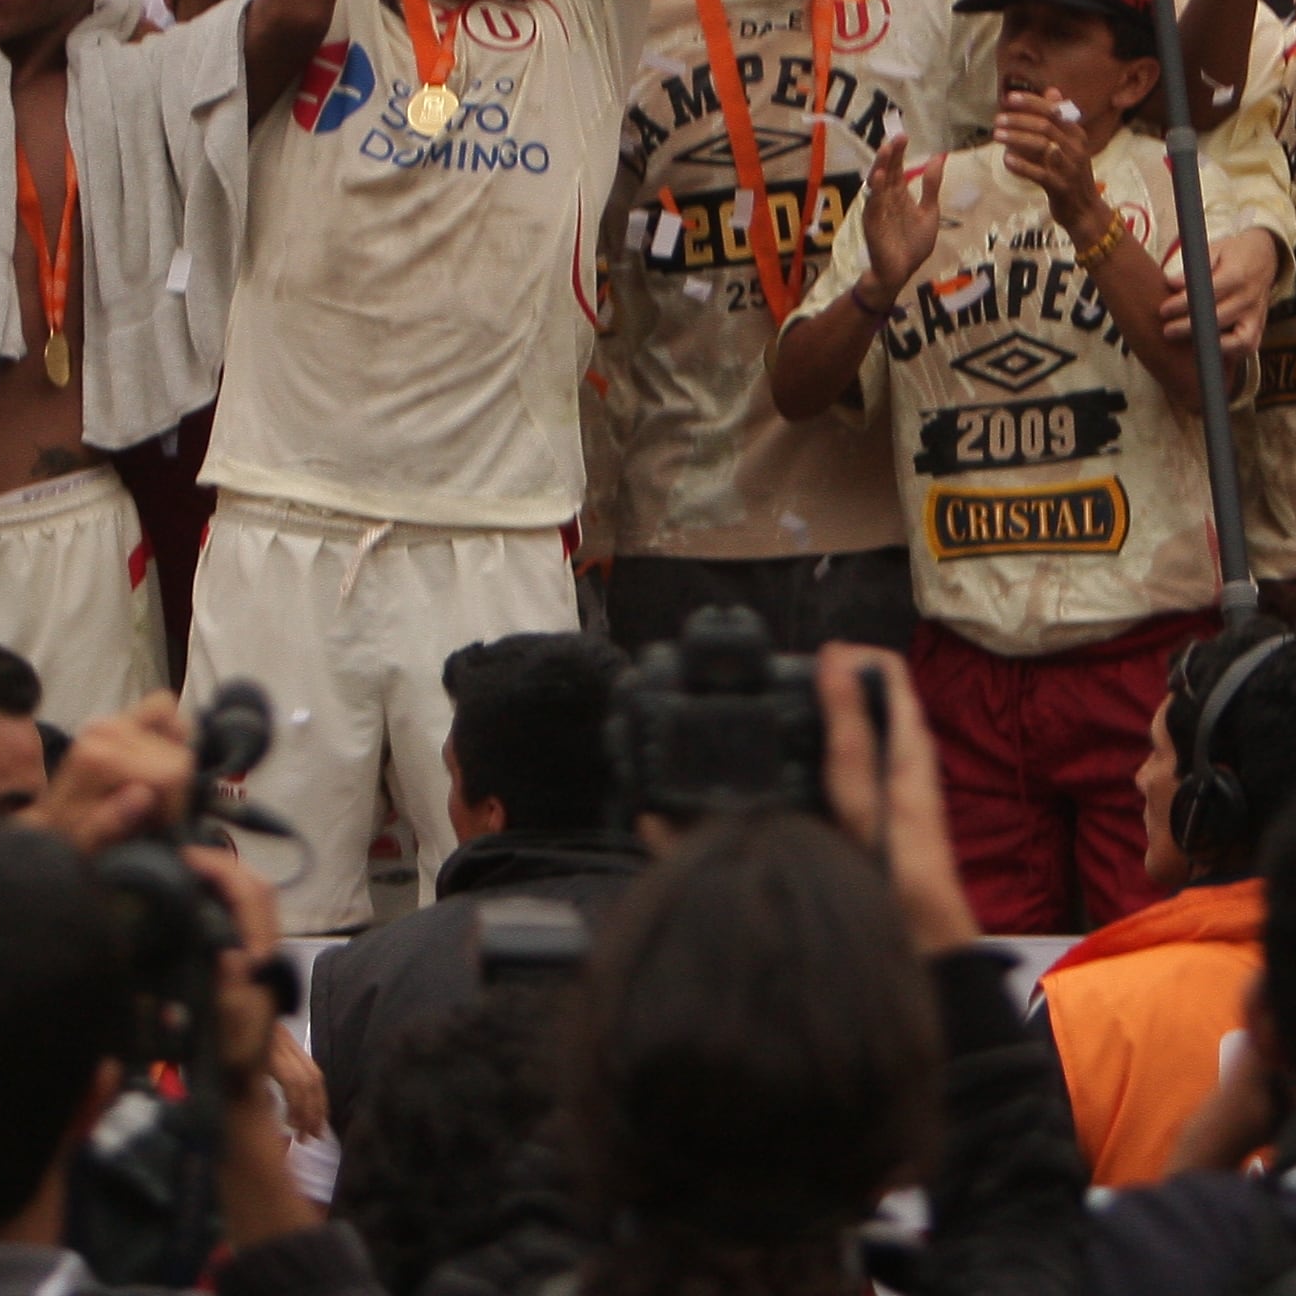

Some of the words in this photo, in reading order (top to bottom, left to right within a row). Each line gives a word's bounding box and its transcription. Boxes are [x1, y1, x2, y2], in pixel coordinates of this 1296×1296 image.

[380, 95, 510, 136] STO
[359, 127, 551, 175] DOMINGO
[955, 404, 1078, 462] 2009
[945, 495, 1106, 542] CRISTAL
